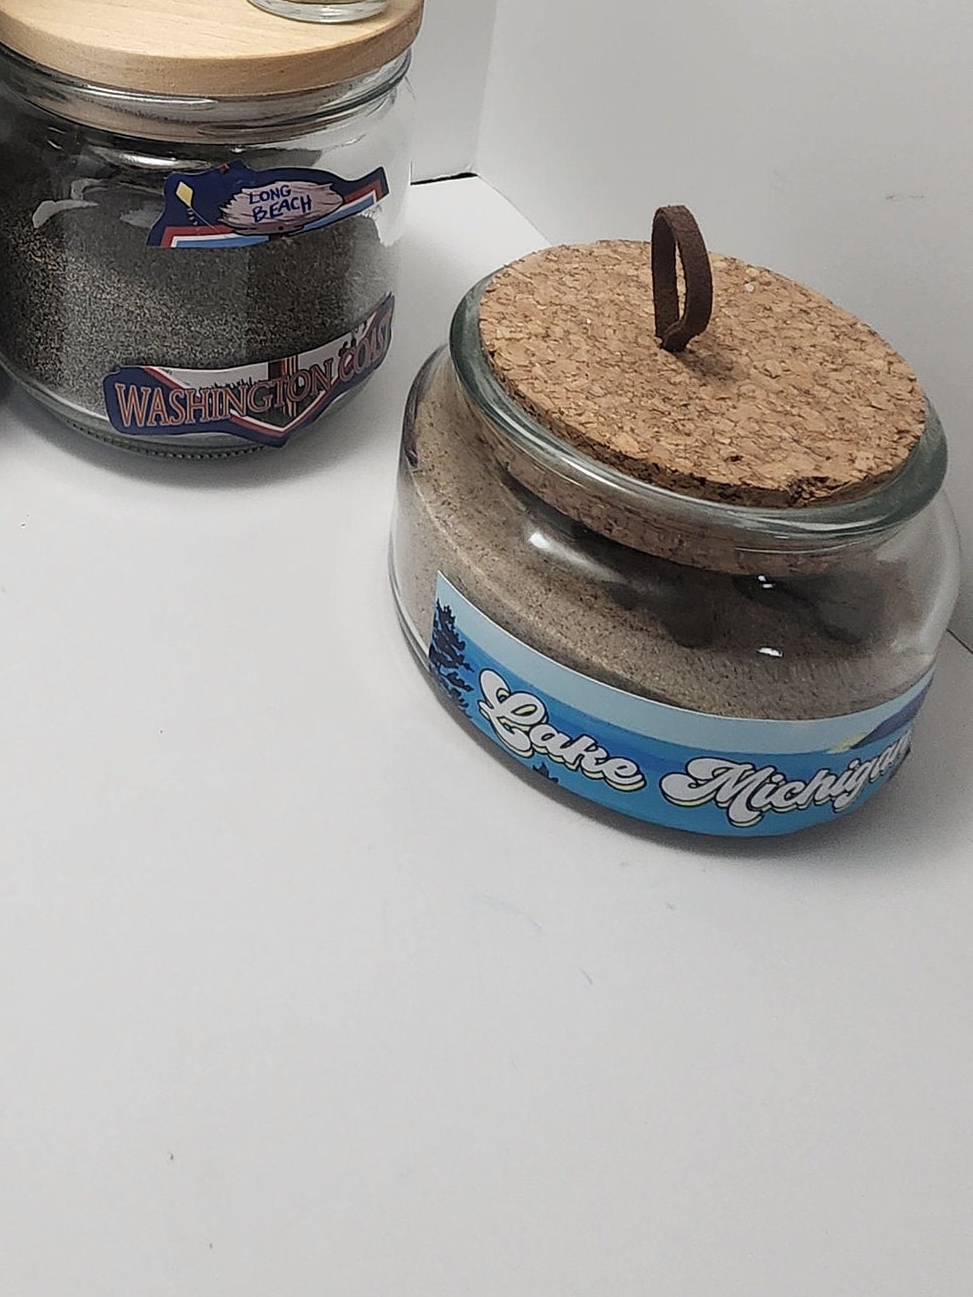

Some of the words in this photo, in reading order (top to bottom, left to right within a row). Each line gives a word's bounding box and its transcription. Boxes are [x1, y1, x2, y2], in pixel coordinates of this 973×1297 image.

[248, 184, 292, 205] LONG
[251, 195, 313, 223] BEACH
[114, 357, 334, 428] WASHINGTON
[477, 668, 647, 792] Lake
